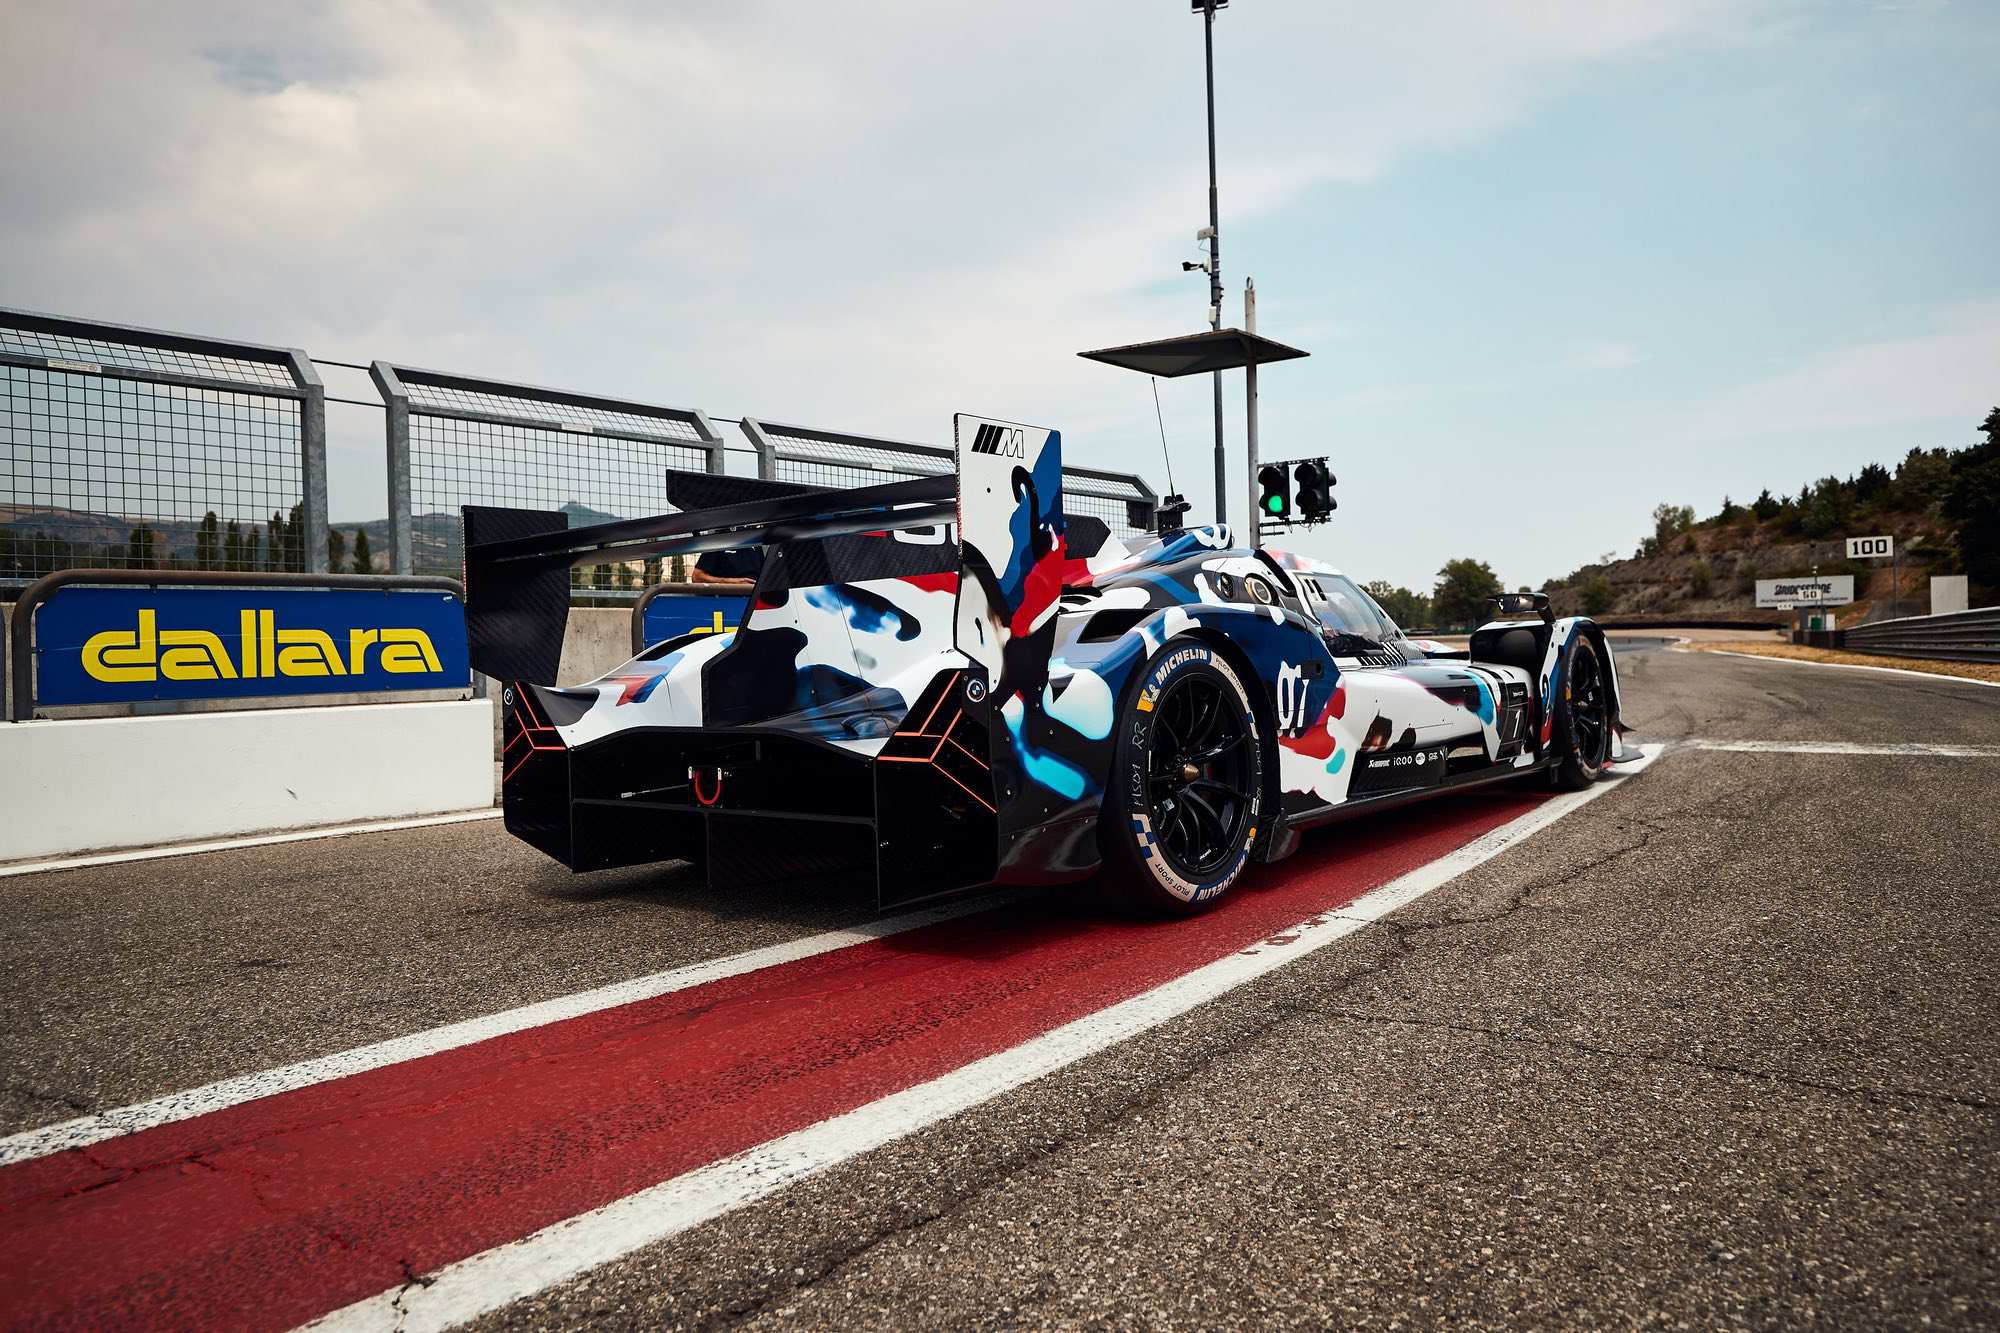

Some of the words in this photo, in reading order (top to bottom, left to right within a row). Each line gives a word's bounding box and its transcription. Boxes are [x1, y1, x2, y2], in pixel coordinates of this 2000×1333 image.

[1852, 539, 1887, 555] 100
[81, 609, 443, 682] dallara
[1155, 648, 1208, 685] MICHELIN
[1132, 721, 1148, 750] RR
[1155, 863, 1174, 885] SPORT
[1197, 854, 1246, 901] MICHELIN
[1173, 882, 1190, 897] PILOT
